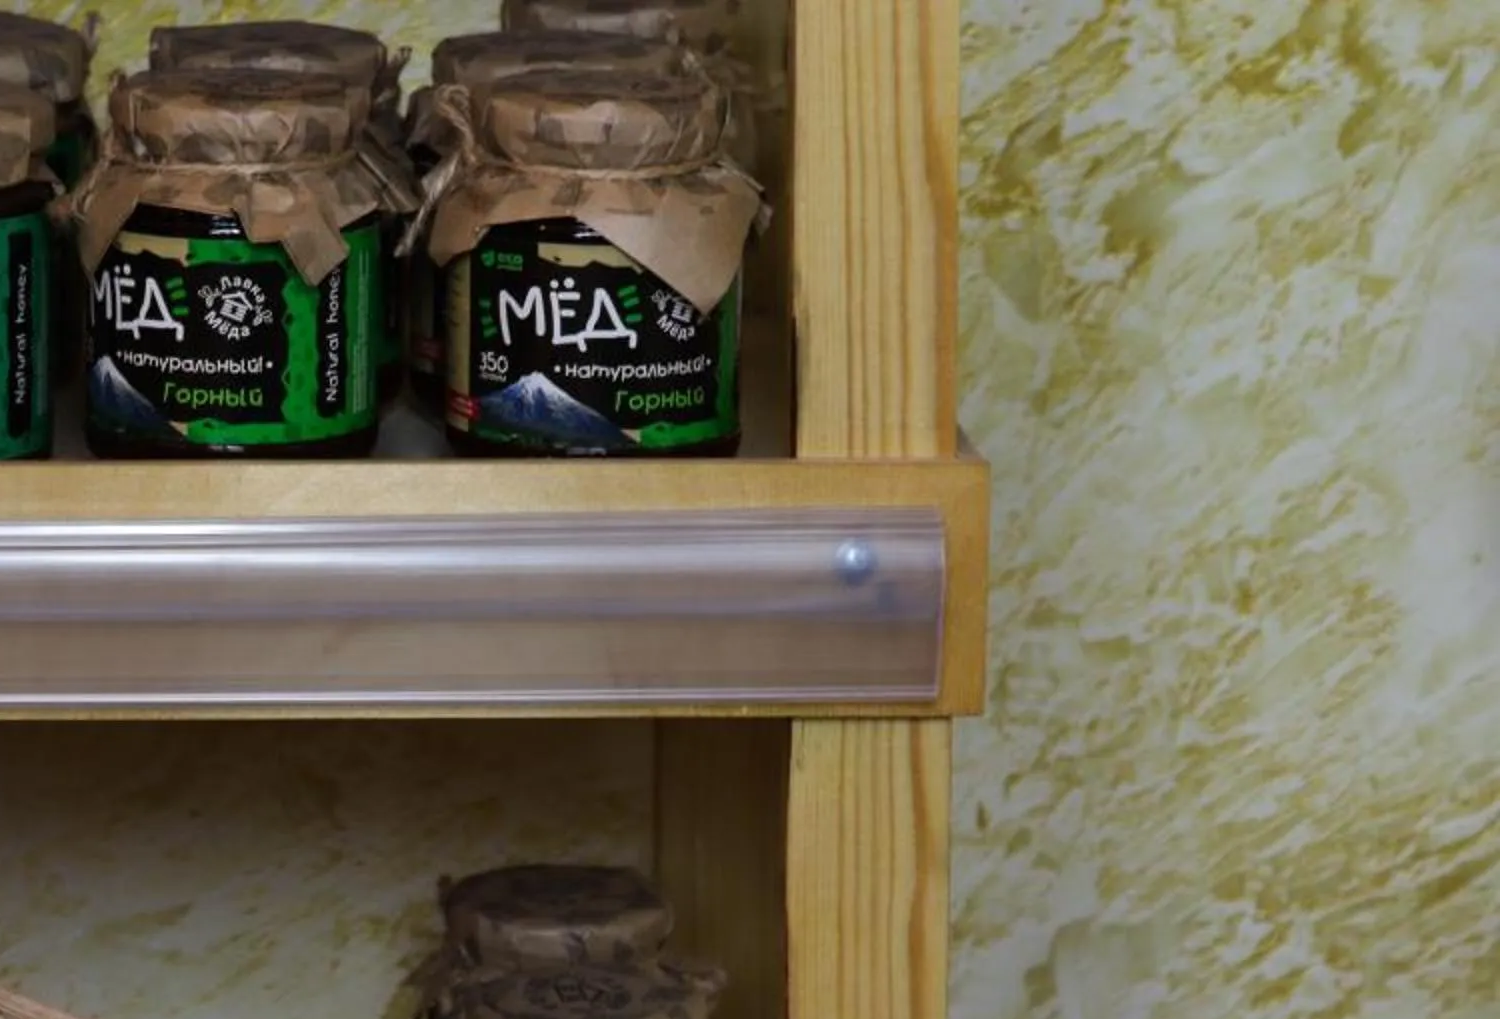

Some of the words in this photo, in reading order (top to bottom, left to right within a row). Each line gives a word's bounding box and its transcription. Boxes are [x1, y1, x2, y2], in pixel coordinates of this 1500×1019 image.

[15, 264, 28, 324] honey
[220, 275, 265, 305] Лавка
[204, 310, 250, 341] Мёда
[499, 277, 637, 352] МЁД
[15, 333, 27, 404] Natural
[326, 333, 340, 402] Natural
[480, 352, 509, 374] 350
[163, 382, 264, 409] Горный
[615, 386, 705, 415] Горный
